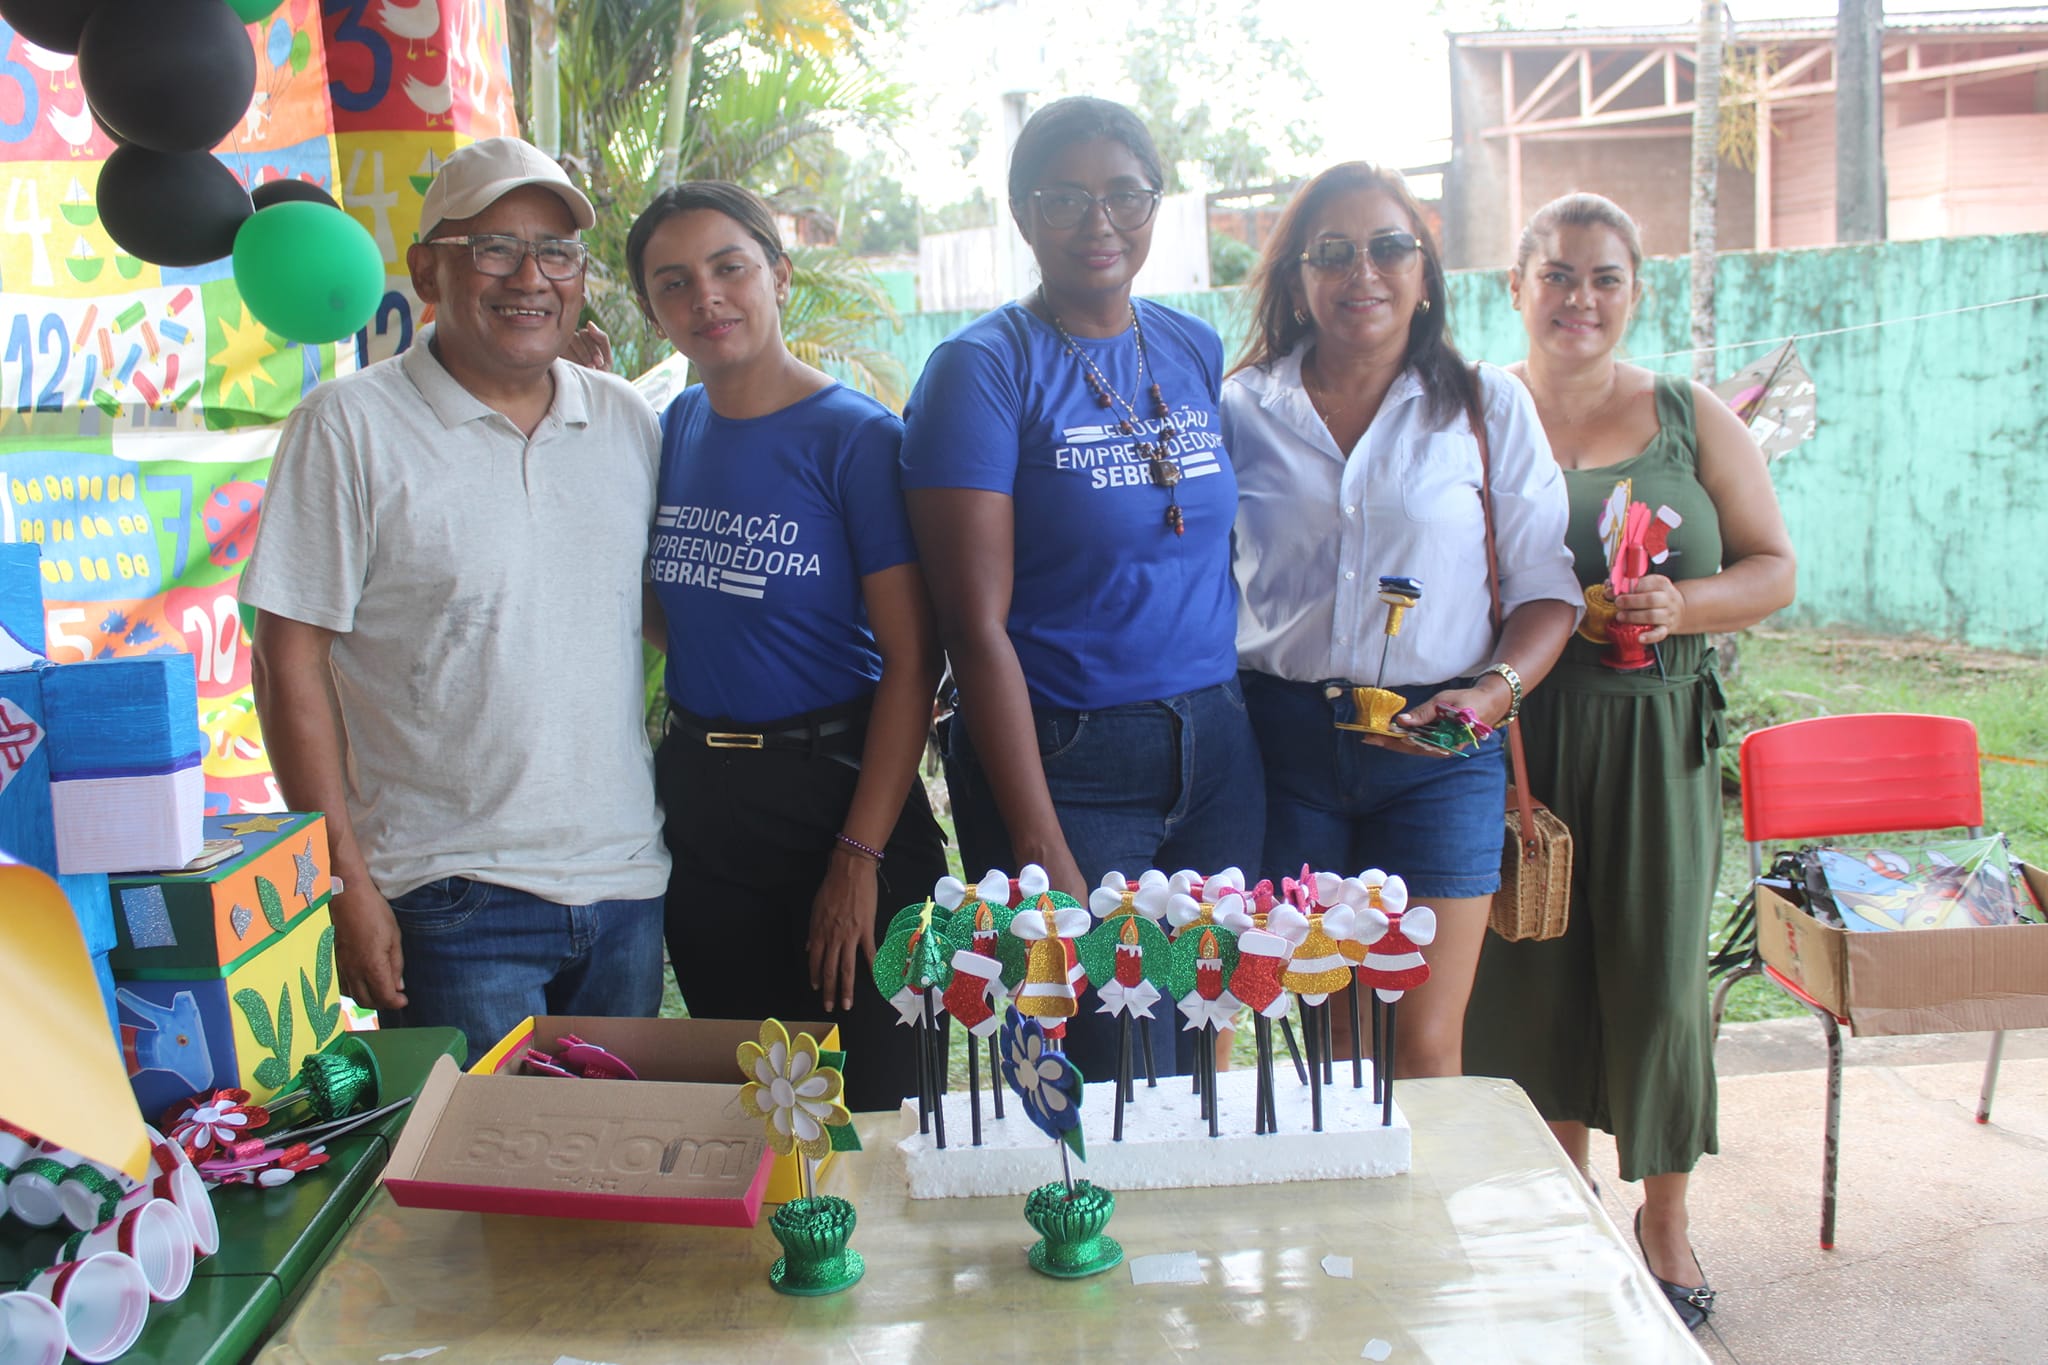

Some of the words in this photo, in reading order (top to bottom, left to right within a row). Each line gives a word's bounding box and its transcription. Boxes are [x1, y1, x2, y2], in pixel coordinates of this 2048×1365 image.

[324, 0, 392, 112] 3
[1, 176, 53, 287] 4
[342, 148, 399, 264] 4
[2, 312, 72, 415] 12
[1091, 457, 1183, 490] SEBR
[145, 474, 194, 579] 7
[651, 533, 821, 577] PREENDEDORA
[676, 505, 799, 547] EDUCAÇÃO
[649, 558, 721, 591] SEBRAE
[47, 608, 94, 662] 5
[182, 594, 241, 685] 10
